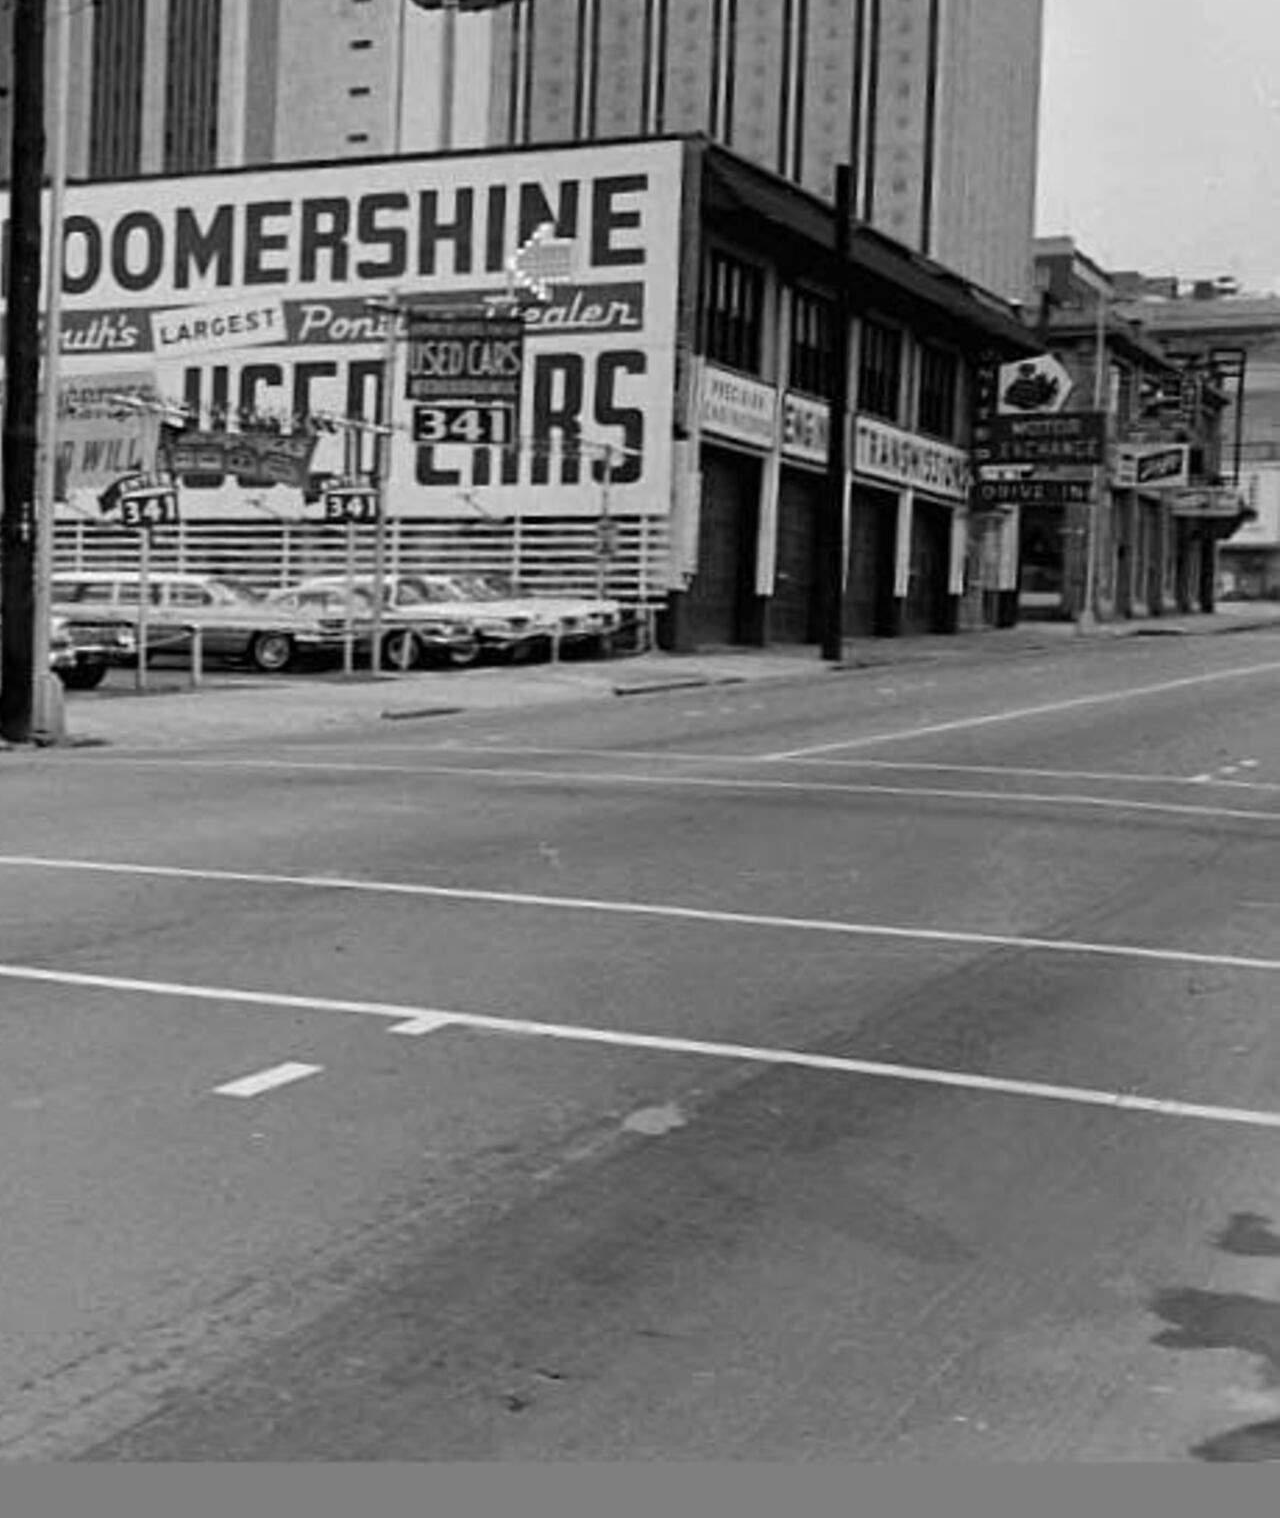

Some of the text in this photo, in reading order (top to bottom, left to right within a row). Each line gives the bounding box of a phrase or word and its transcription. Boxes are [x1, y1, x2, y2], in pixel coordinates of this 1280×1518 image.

[2, 172, 648, 295] OOMERSHINE
[161, 309, 277, 345] LARGEST
[408, 336, 522, 376] USED CARS
[421, 409, 504, 441] 341
[124, 493, 178, 524] 341
[325, 493, 377, 519] 341
